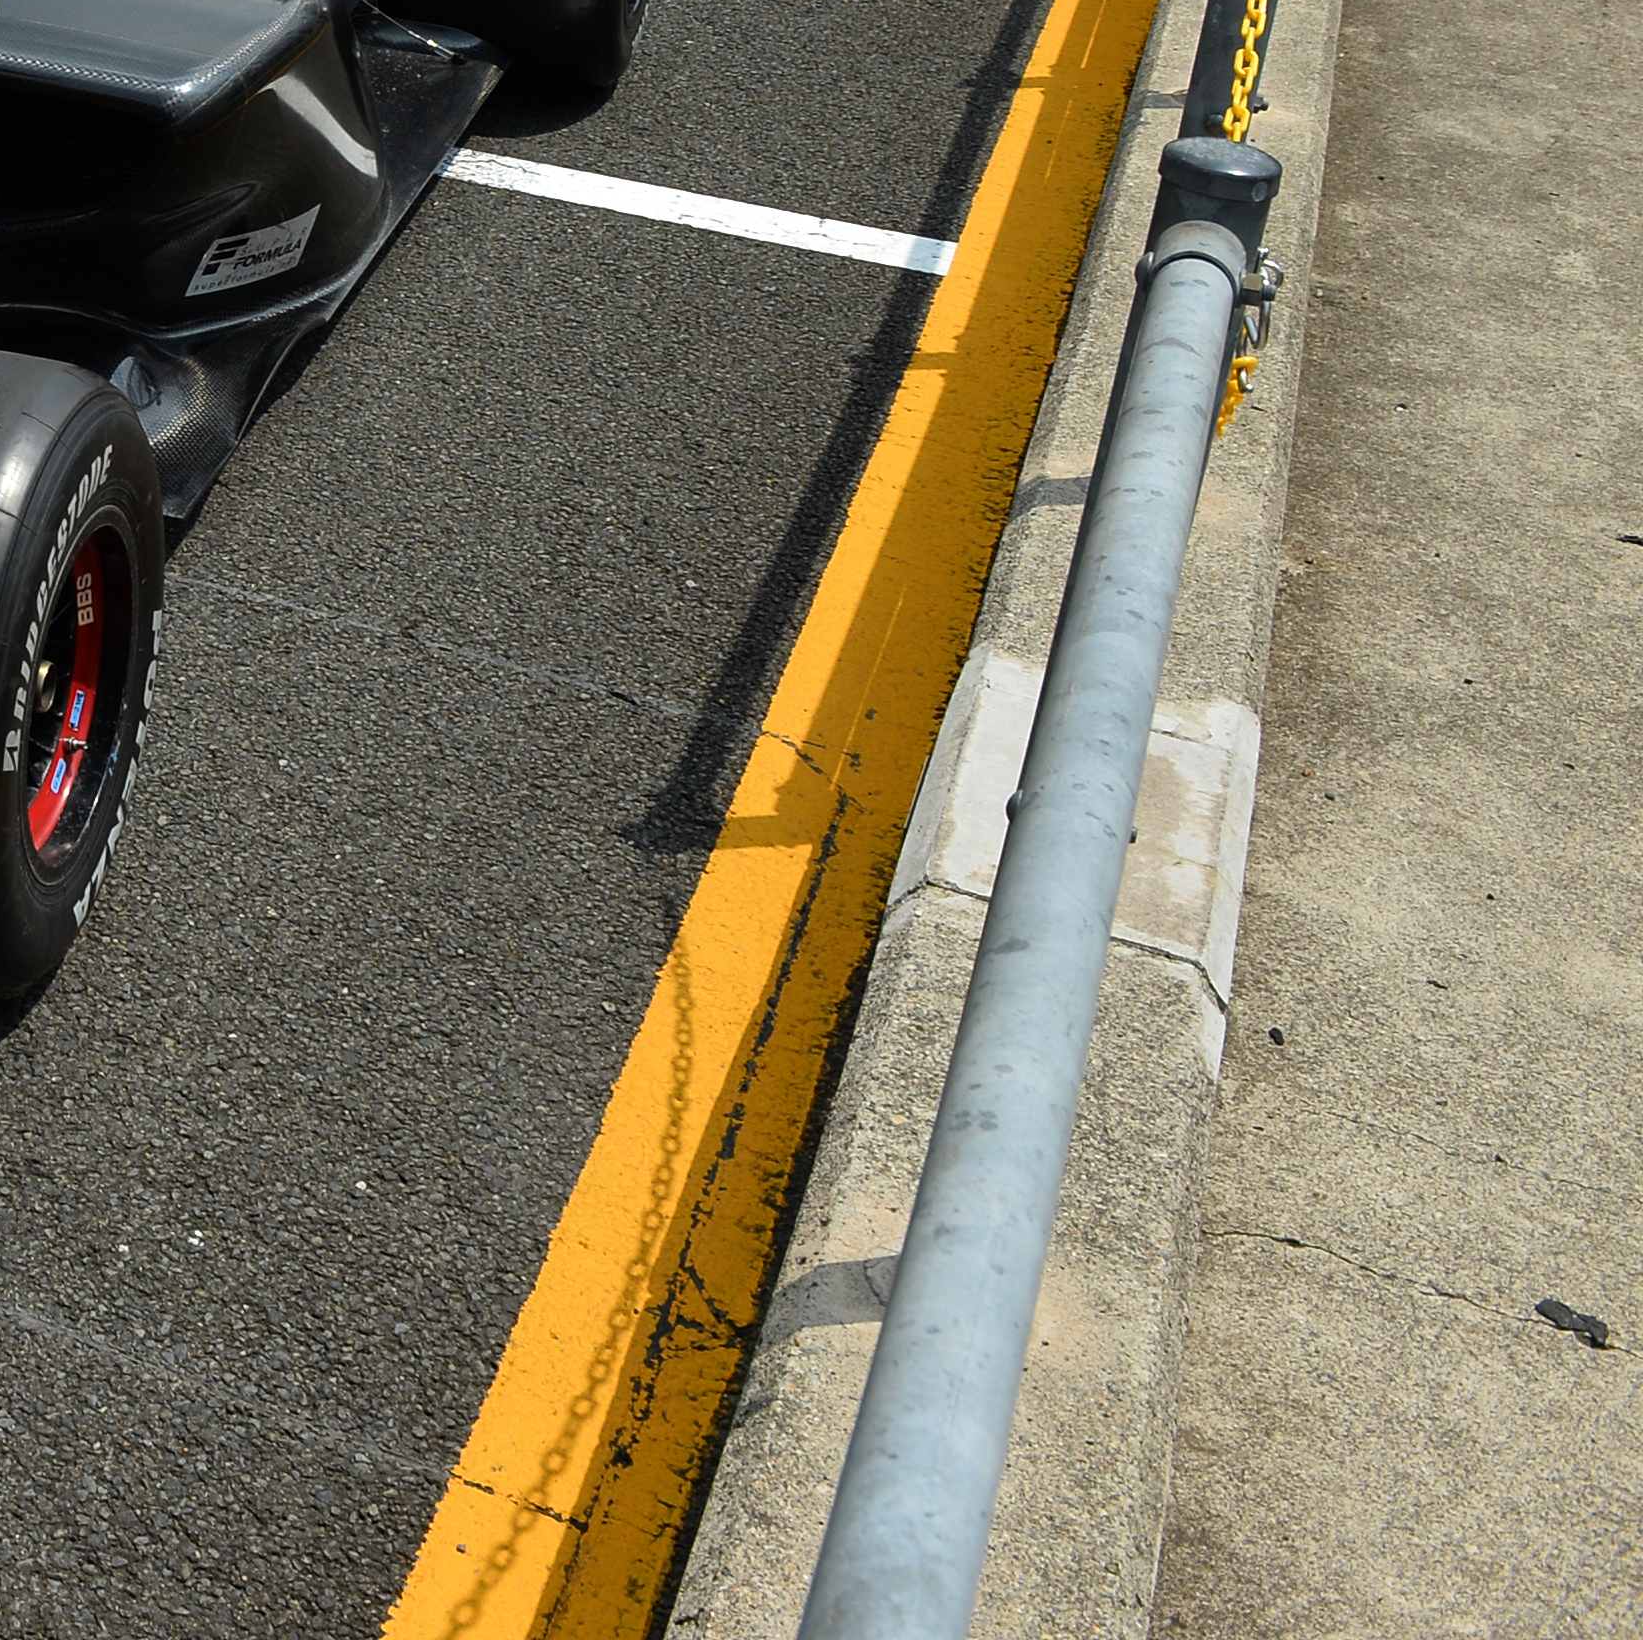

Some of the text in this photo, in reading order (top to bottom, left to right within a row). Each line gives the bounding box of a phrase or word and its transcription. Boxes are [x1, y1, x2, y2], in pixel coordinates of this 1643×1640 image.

[233, 238, 303, 271] FORMULA
[3, 444, 113, 773] BRIDGESTONE
[76, 572, 94, 626] BBS
